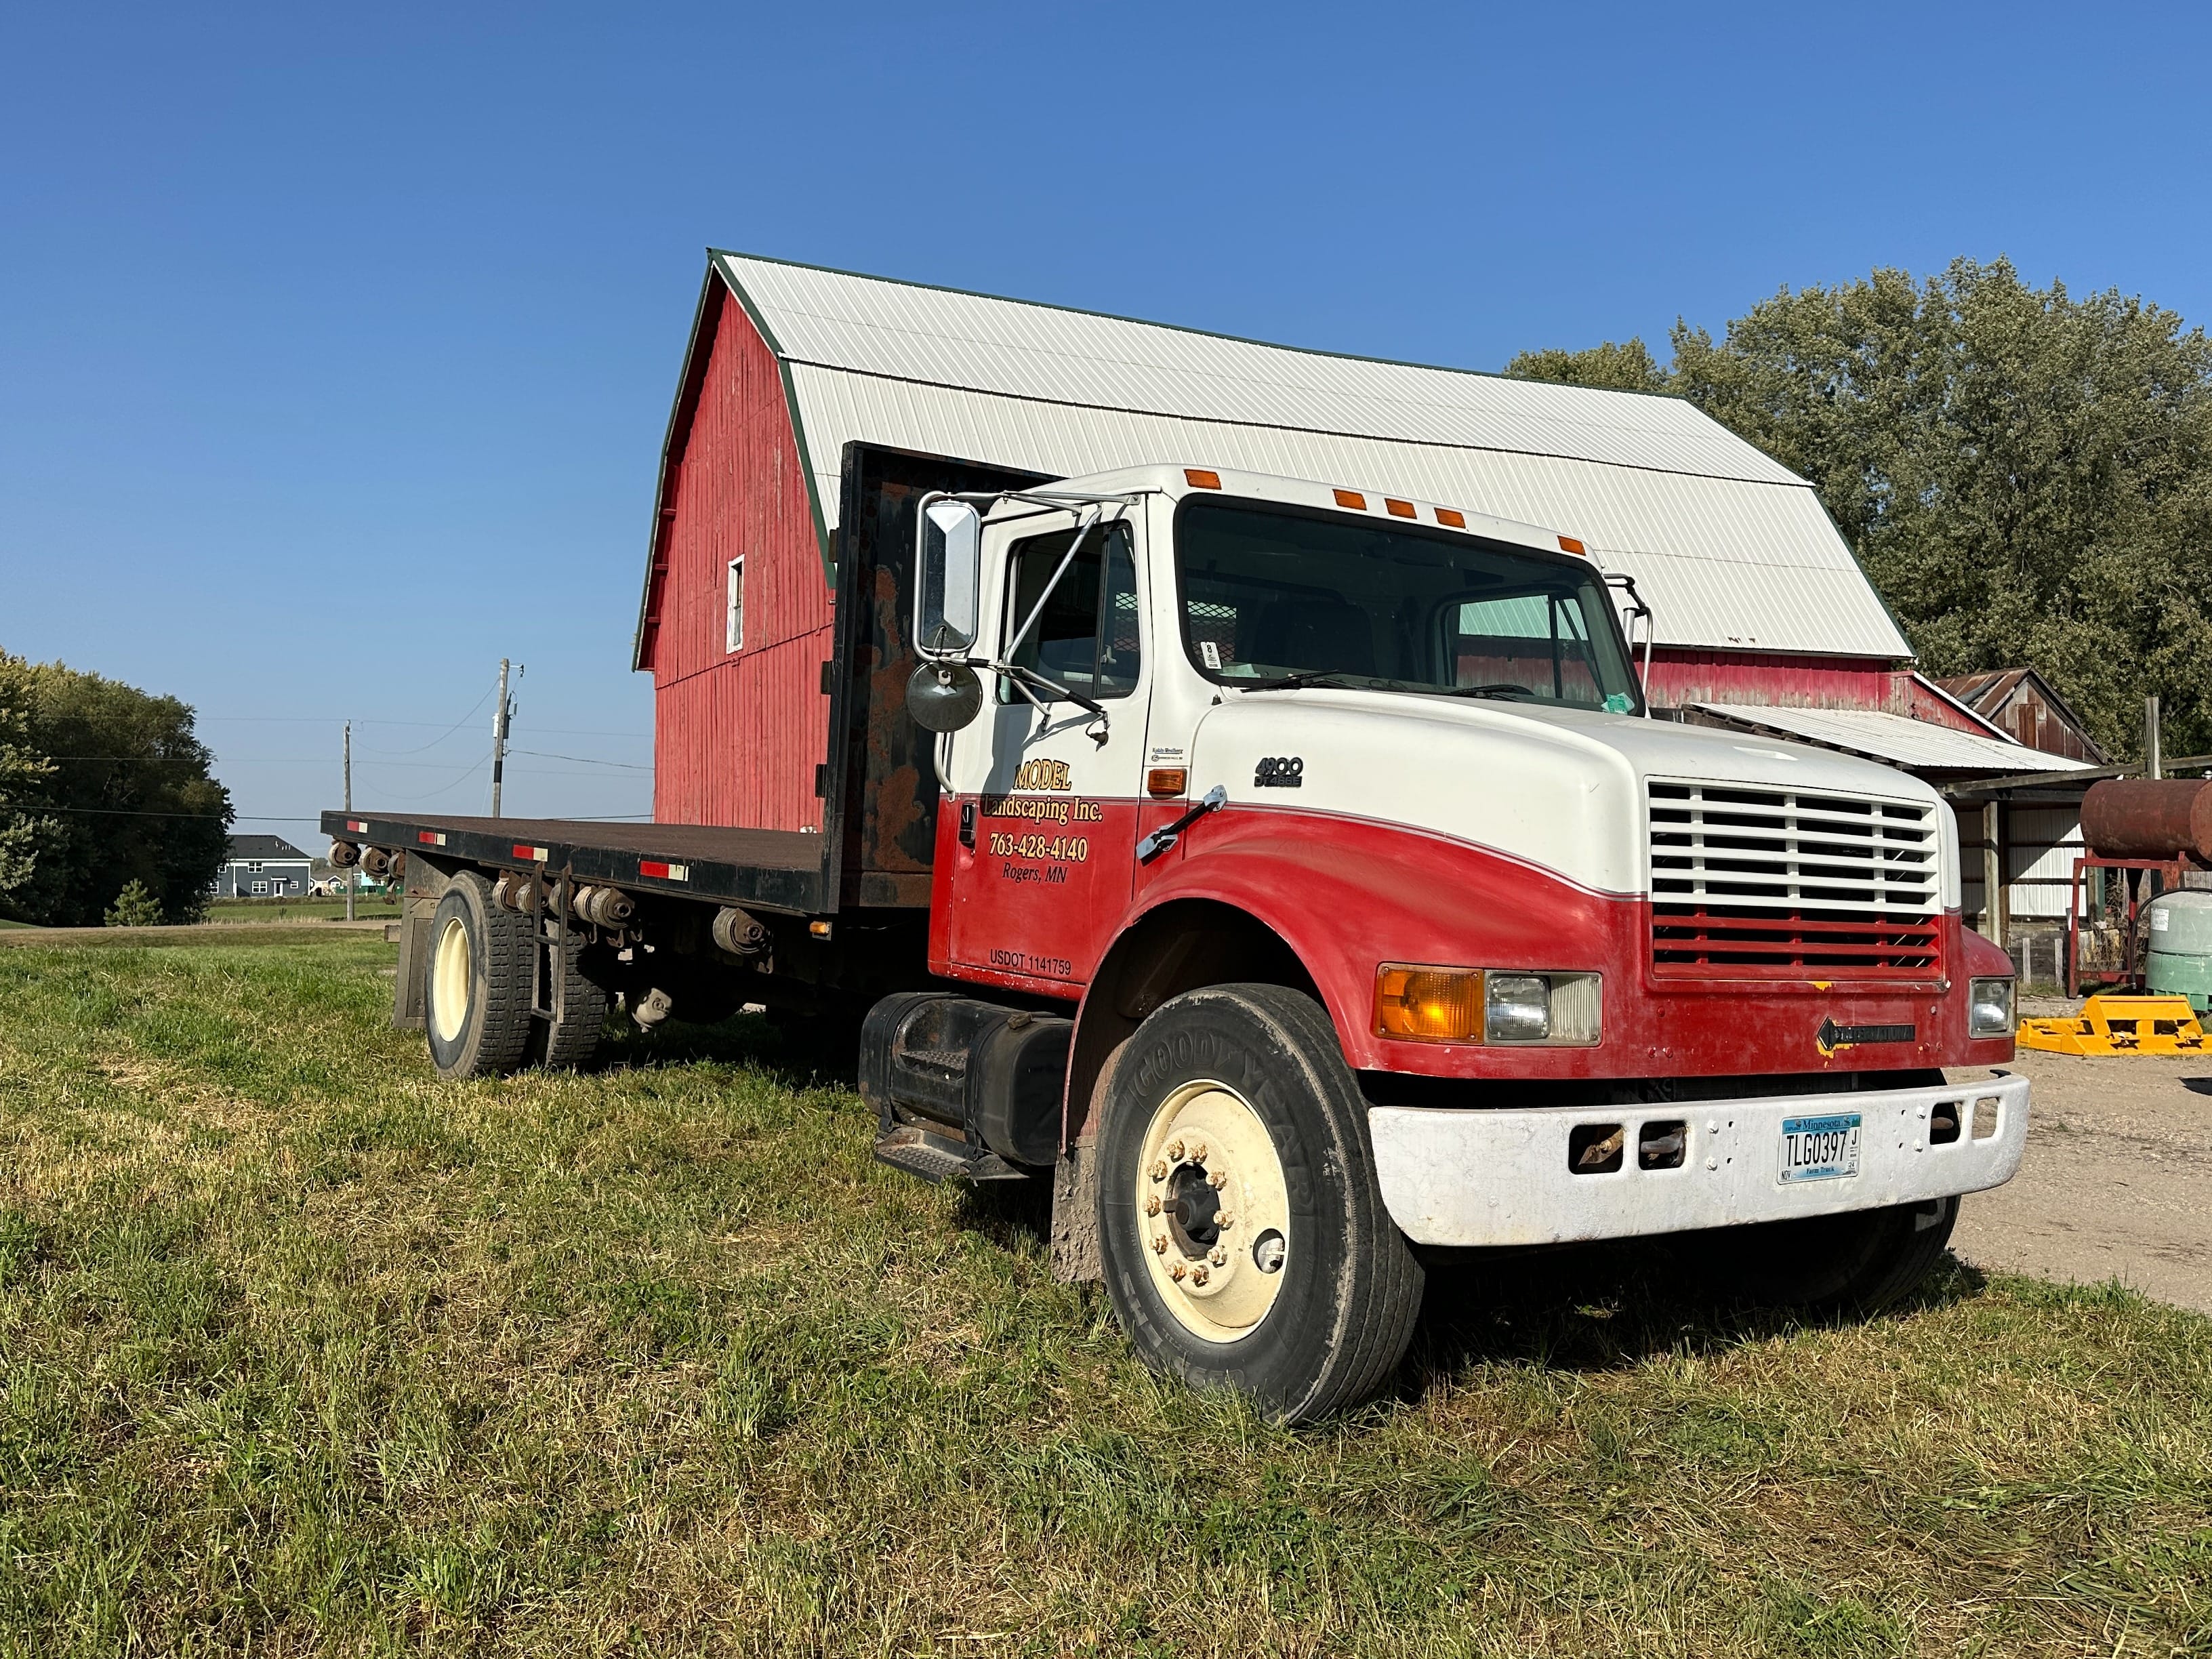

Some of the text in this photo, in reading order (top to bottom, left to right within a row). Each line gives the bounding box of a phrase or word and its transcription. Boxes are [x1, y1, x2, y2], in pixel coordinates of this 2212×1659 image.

[1012, 758, 1072, 791] MODEL
[1255, 757, 1303, 776] 4900
[982, 794, 1104, 826] Landscaping Inc.
[989, 832, 1088, 863] 763-428-4140
[1002, 862, 1069, 884] Rogers, MN
[990, 948, 1071, 976] USDOT 1141759
[1786, 1130, 1847, 1167] TLG0397
[1851, 1129, 1858, 1145] J
[1820, 1165, 1835, 1173] Truck
